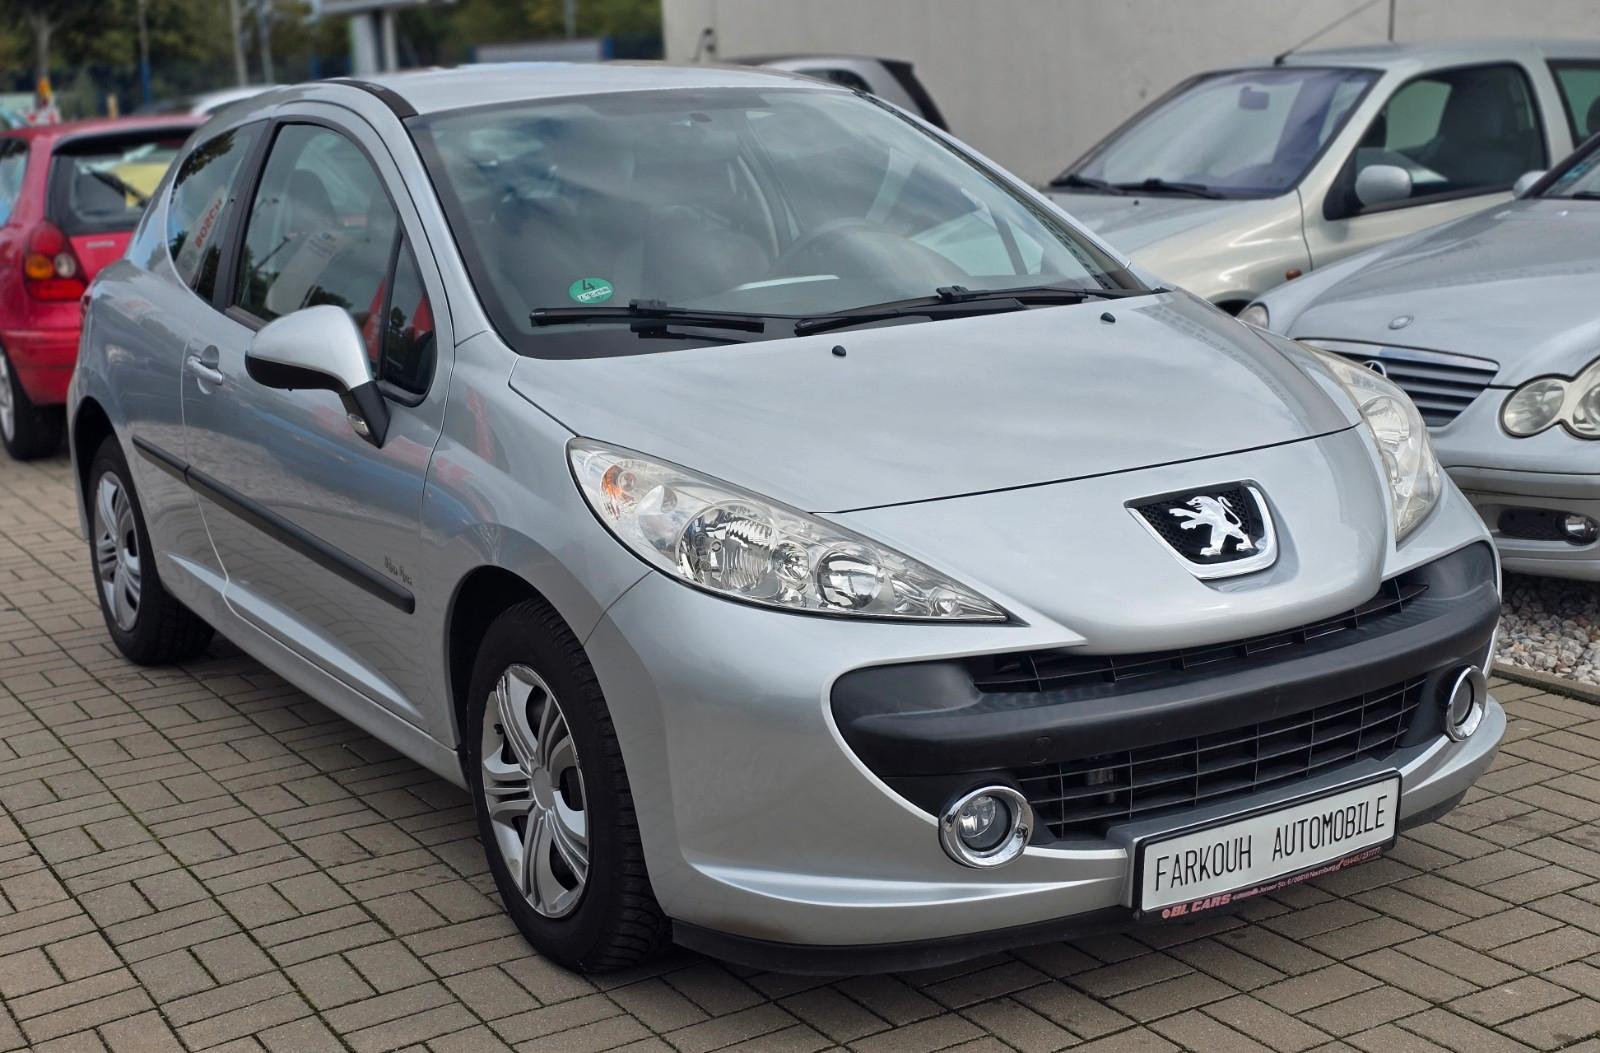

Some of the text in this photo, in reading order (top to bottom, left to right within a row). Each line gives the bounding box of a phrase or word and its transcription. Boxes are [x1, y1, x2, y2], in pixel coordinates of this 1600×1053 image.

[1155, 794, 1388, 892] FARKOUH AUTOMOBILE
[1170, 904, 1189, 918] BL
[1191, 894, 1232, 912] CARS
